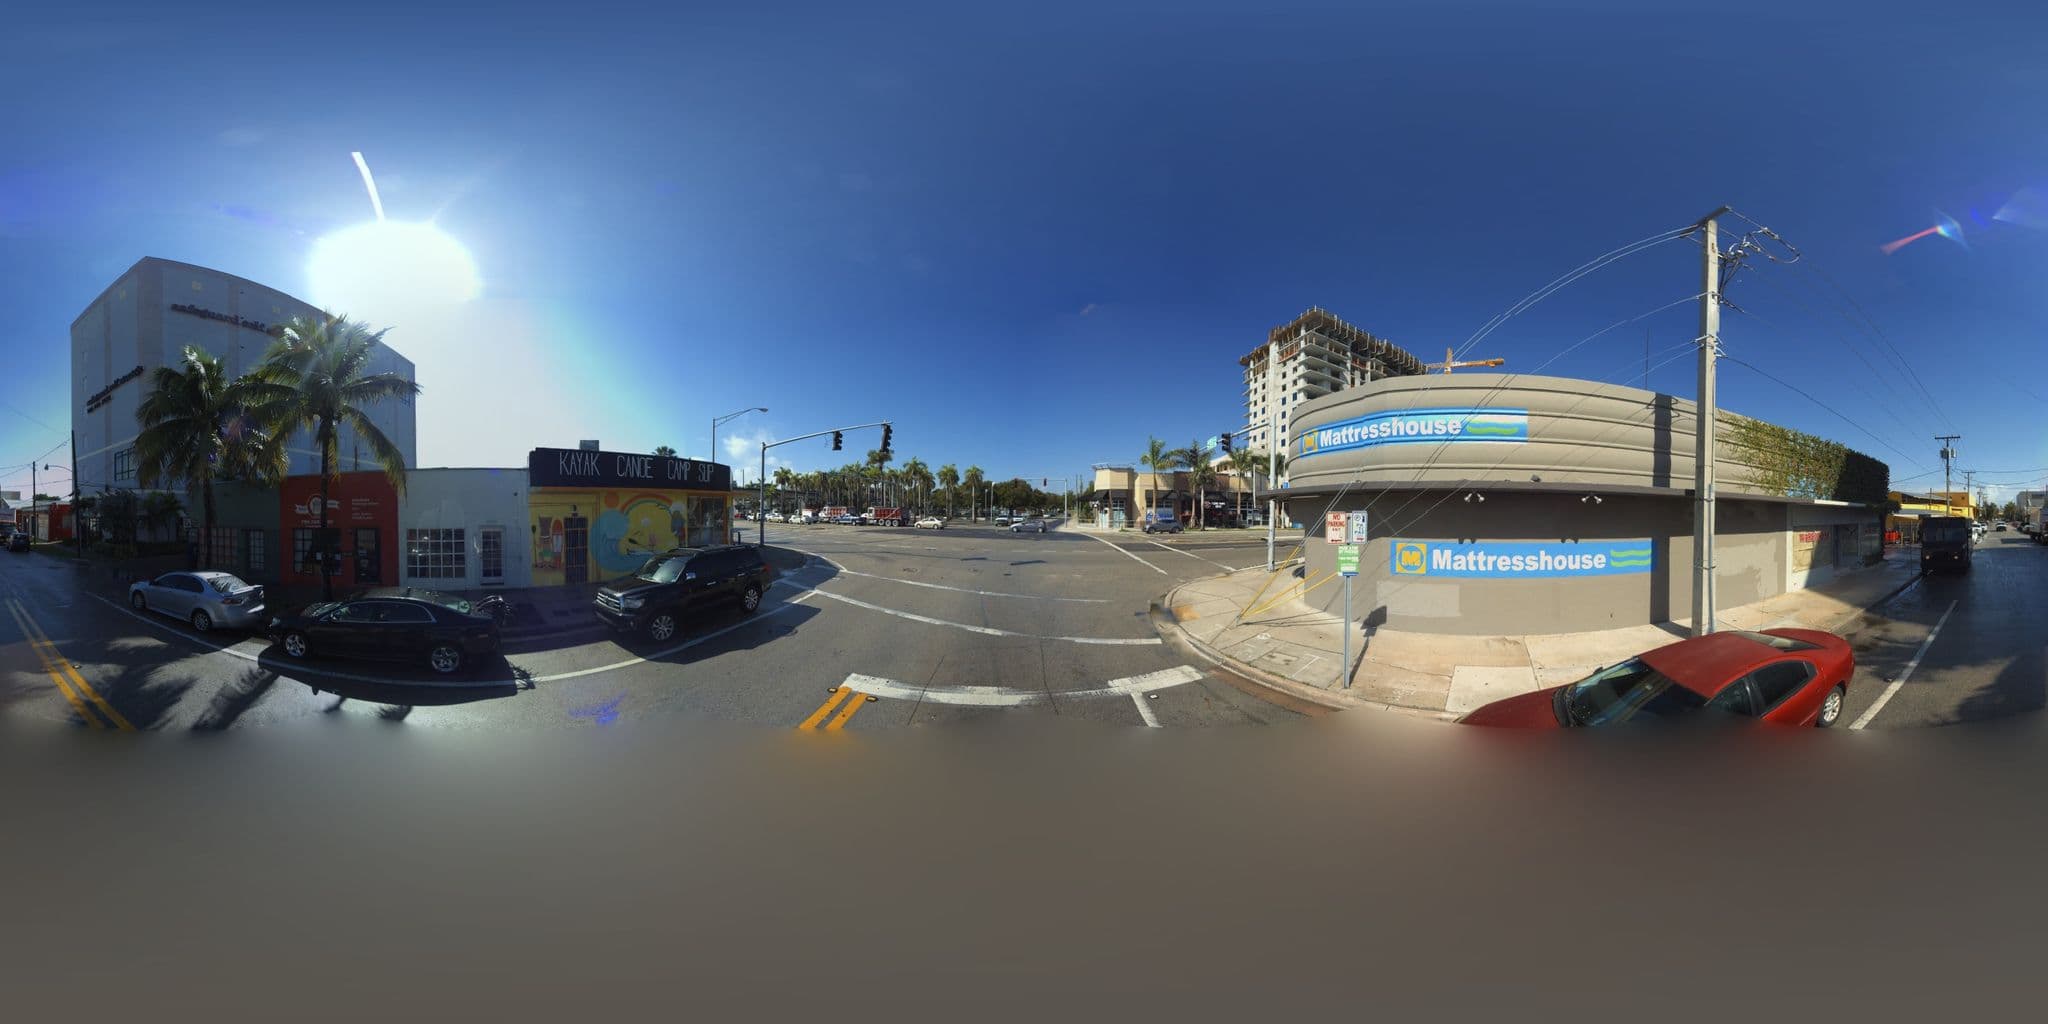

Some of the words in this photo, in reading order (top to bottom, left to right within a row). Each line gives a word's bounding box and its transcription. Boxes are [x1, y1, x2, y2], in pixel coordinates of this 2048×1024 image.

[1320, 416, 1462, 448] Mattresshouse
[559, 452, 600, 476] KAYAK
[616, 455, 653, 478] CANOE
[667, 460, 690, 480] CAMP
[1432, 549, 1607, 572] Mattresshouse
